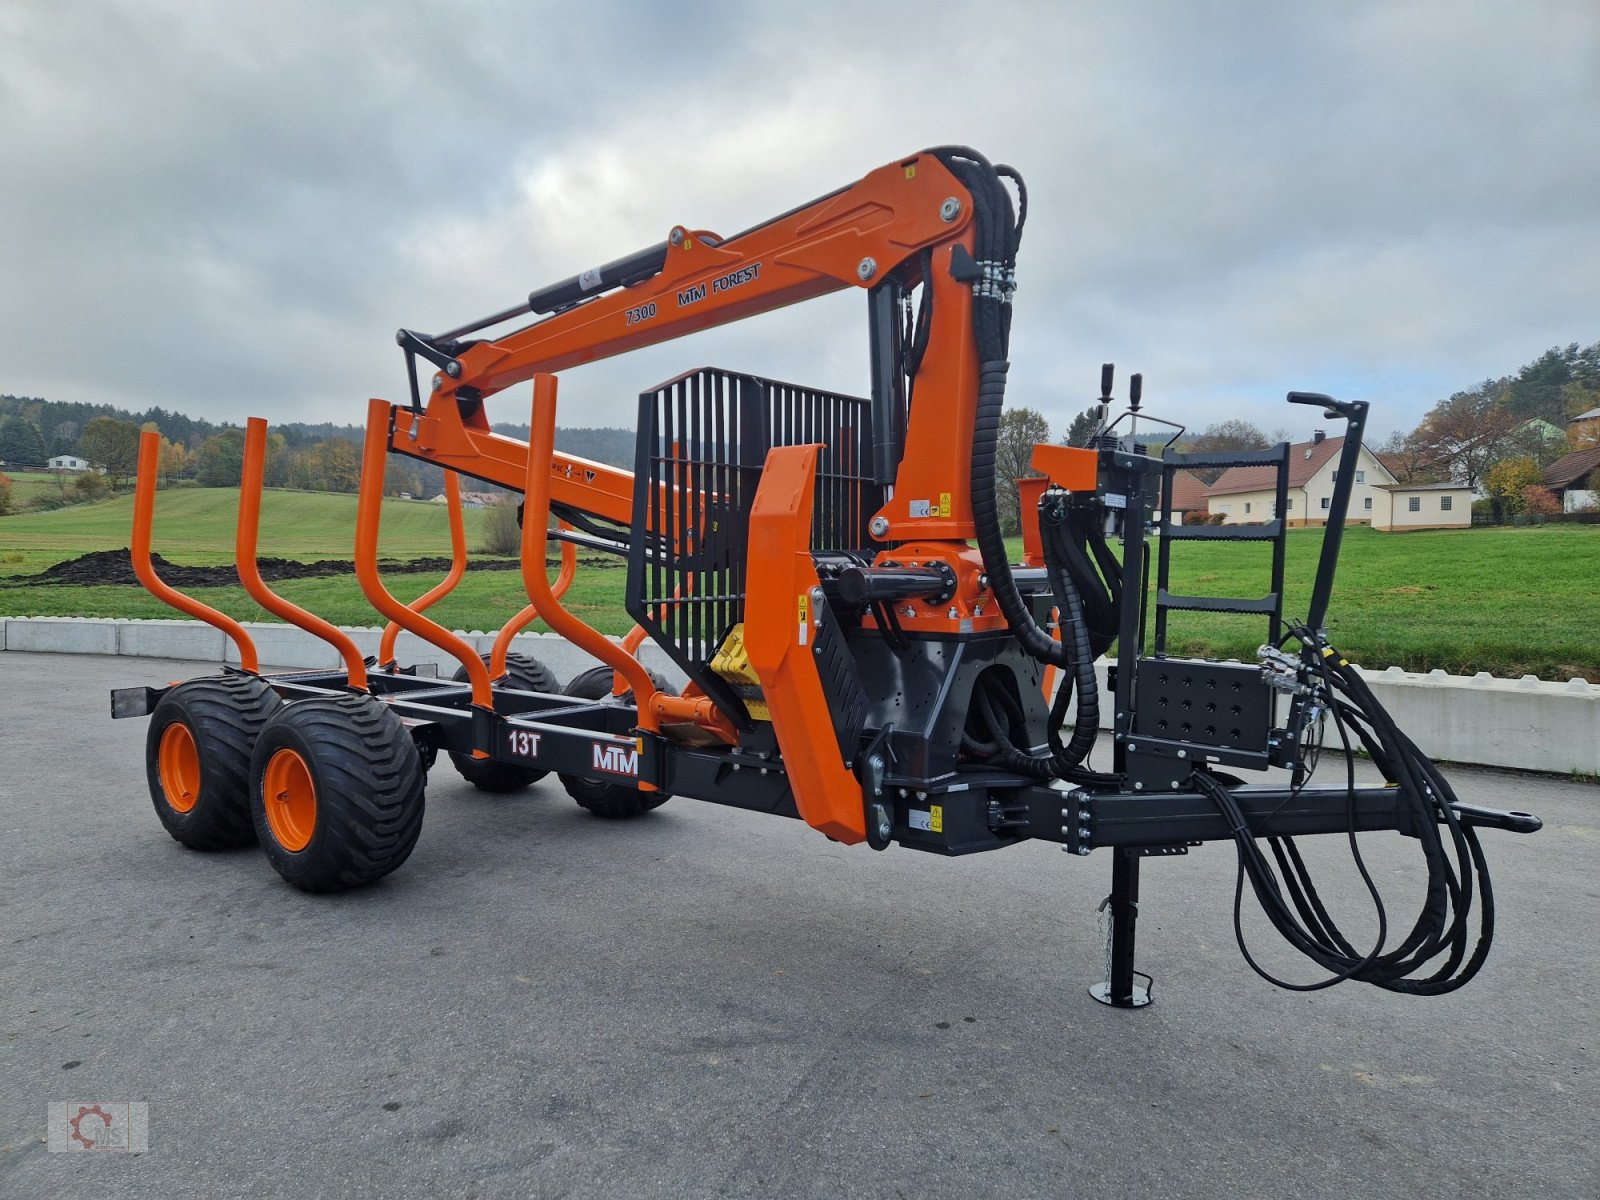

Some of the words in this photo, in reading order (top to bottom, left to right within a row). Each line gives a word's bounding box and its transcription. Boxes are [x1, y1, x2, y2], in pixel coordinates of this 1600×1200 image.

[625, 303, 657, 326] 7300
[678, 284, 706, 307] MTM
[713, 263, 761, 294] FOREST
[509, 731, 541, 757] 13T
[593, 743, 638, 775] MTM
